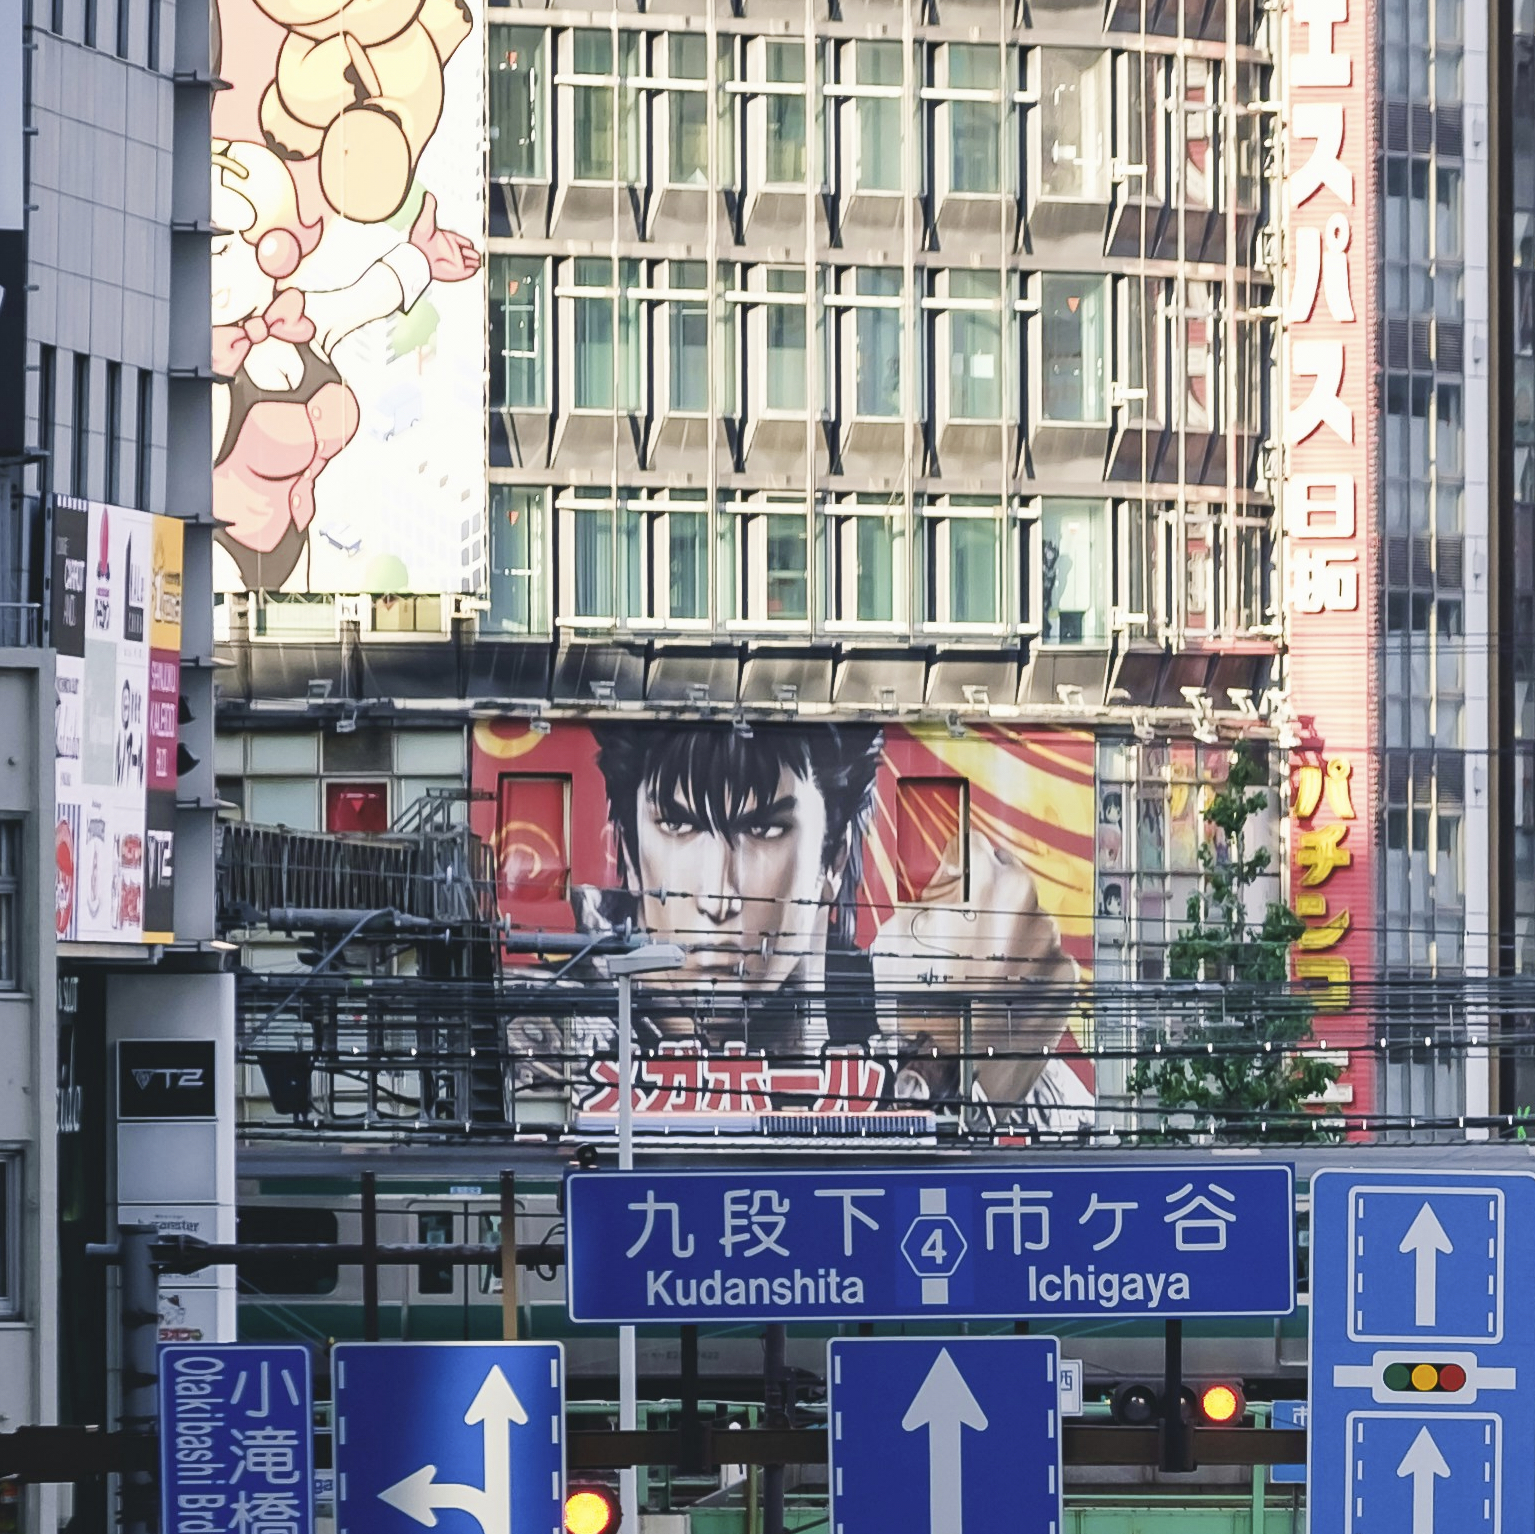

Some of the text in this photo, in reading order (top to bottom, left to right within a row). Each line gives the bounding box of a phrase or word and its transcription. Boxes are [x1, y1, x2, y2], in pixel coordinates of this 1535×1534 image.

[1293, 757, 1356, 1012] パチンコ
[626, 1187, 886, 1258] 九段下
[921, 1224, 945, 1263] 4
[646, 1265, 1191, 1307] Kudanshita Ichigaya
[173, 1356, 226, 1485] Otakibashi
